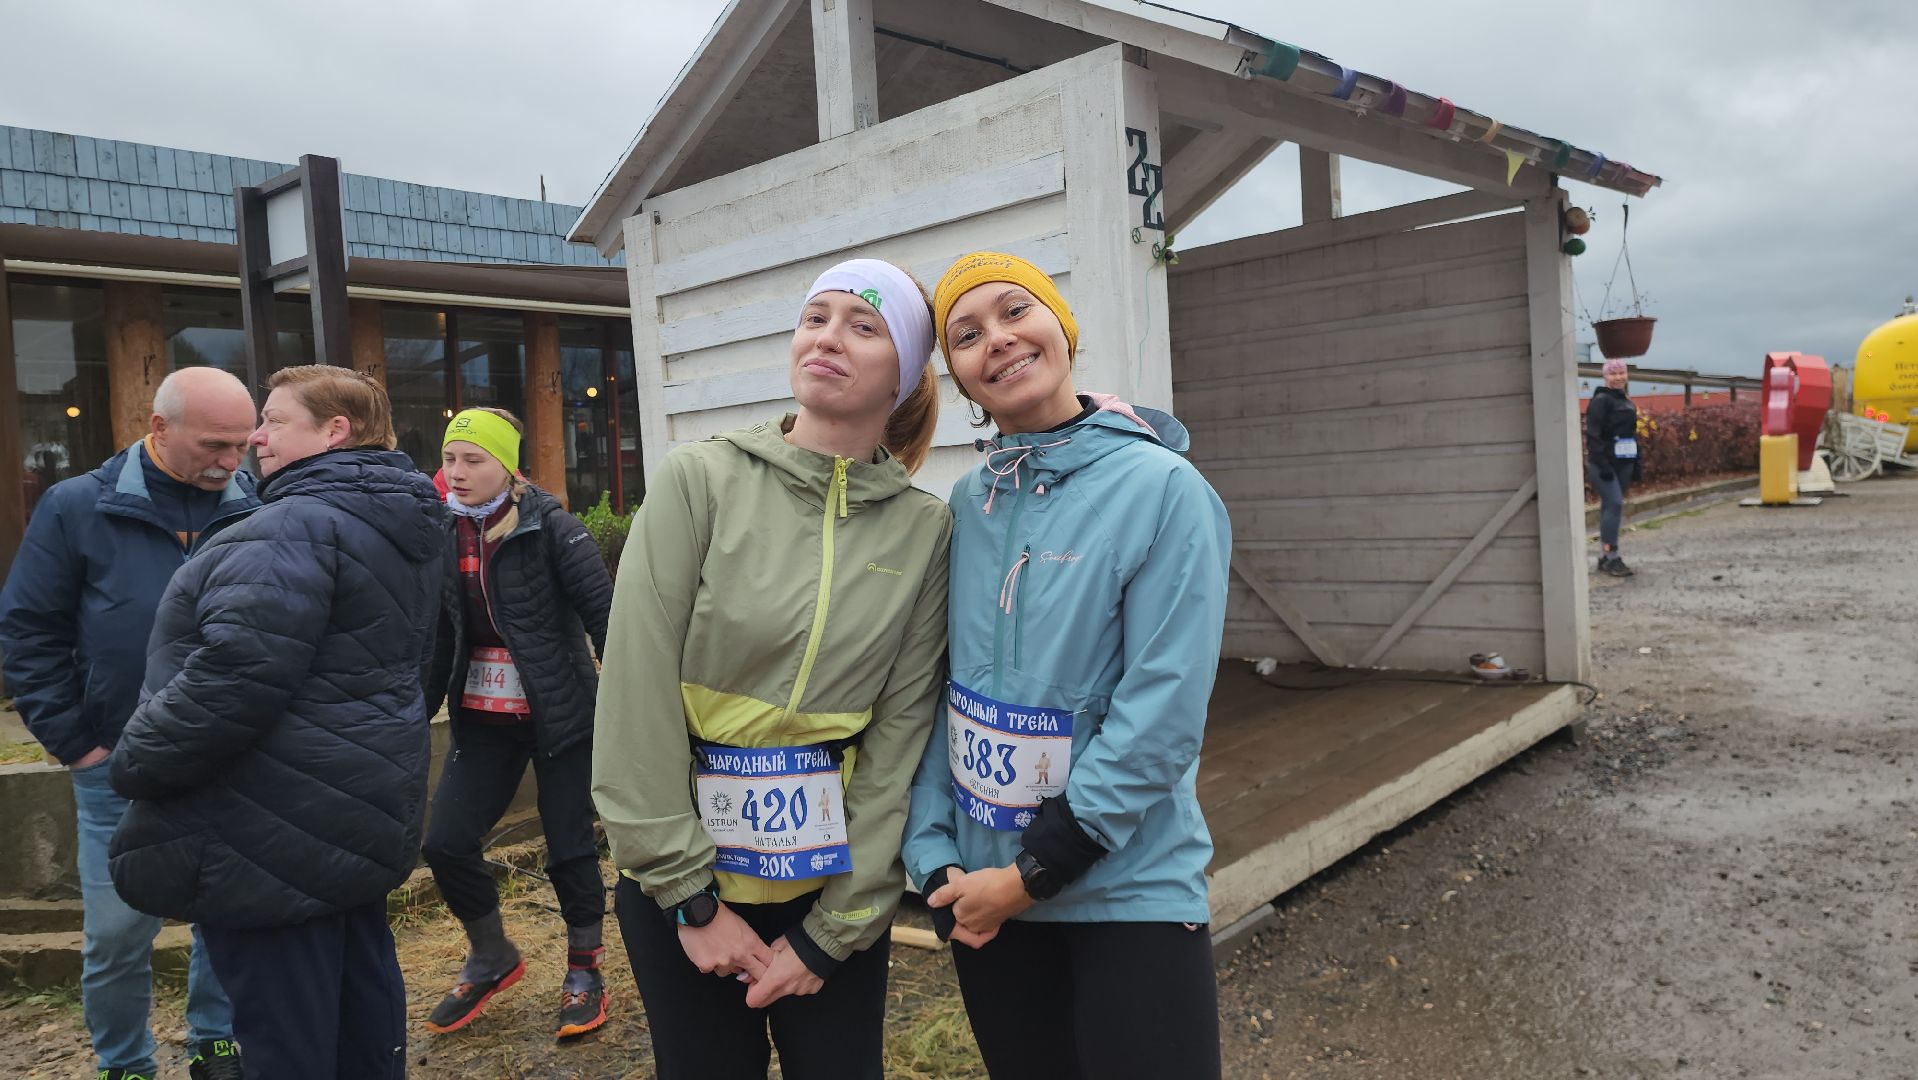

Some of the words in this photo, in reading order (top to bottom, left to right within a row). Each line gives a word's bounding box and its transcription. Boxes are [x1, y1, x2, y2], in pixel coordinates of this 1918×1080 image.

[1125, 127, 1165, 231] 22
[481, 667, 504, 688] 144
[1006, 712, 1059, 731] ТРЕЙЛ
[707, 751, 786, 775] НАРОДНЫЙ
[795, 749, 831, 770] ТРЕЙЛ
[963, 729, 1017, 786] 383
[741, 786, 808, 832] 420
[754, 836, 797, 848] НАТАЛЬЯ
